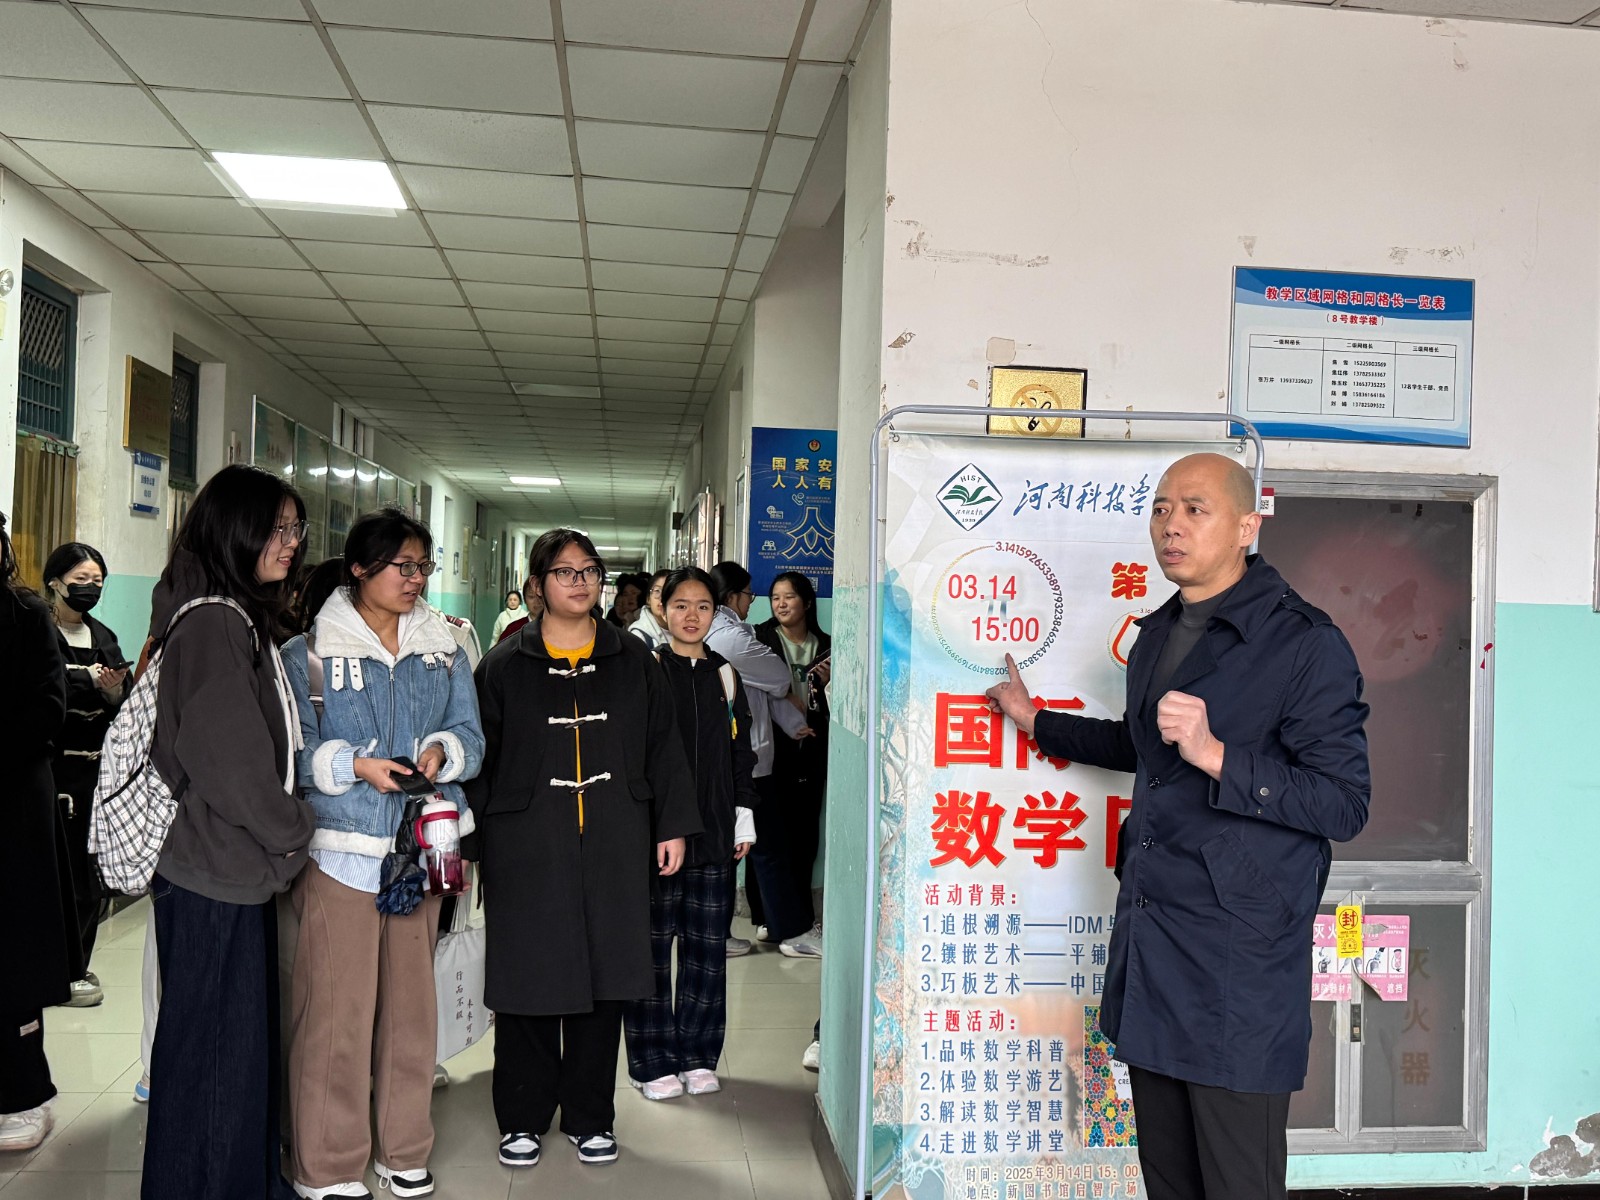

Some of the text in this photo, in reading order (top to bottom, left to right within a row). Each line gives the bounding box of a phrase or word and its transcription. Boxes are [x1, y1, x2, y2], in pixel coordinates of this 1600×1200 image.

[1265, 286, 1445, 310] 教学区域网格和网格长一览表
[1412, 345, 1440, 353] 三级网格长
[772, 457, 833, 472] 国家安
[772, 474, 833, 491] 人人有
[960, 474, 982, 483] HIST
[948, 574, 1017, 600] 03.14
[1111, 562, 1149, 600] 第
[972, 616, 1040, 642] 15:00
[1341, 911, 1356, 927] 封
[921, 1038, 1064, 1063] 1.品味数学科普
[920, 1068, 1063, 1093] 2.体验数学游艺
[920, 1099, 1063, 1124] 3.解读数学智慧
[920, 1129, 1064, 1154] 4.走进数学讲堂
